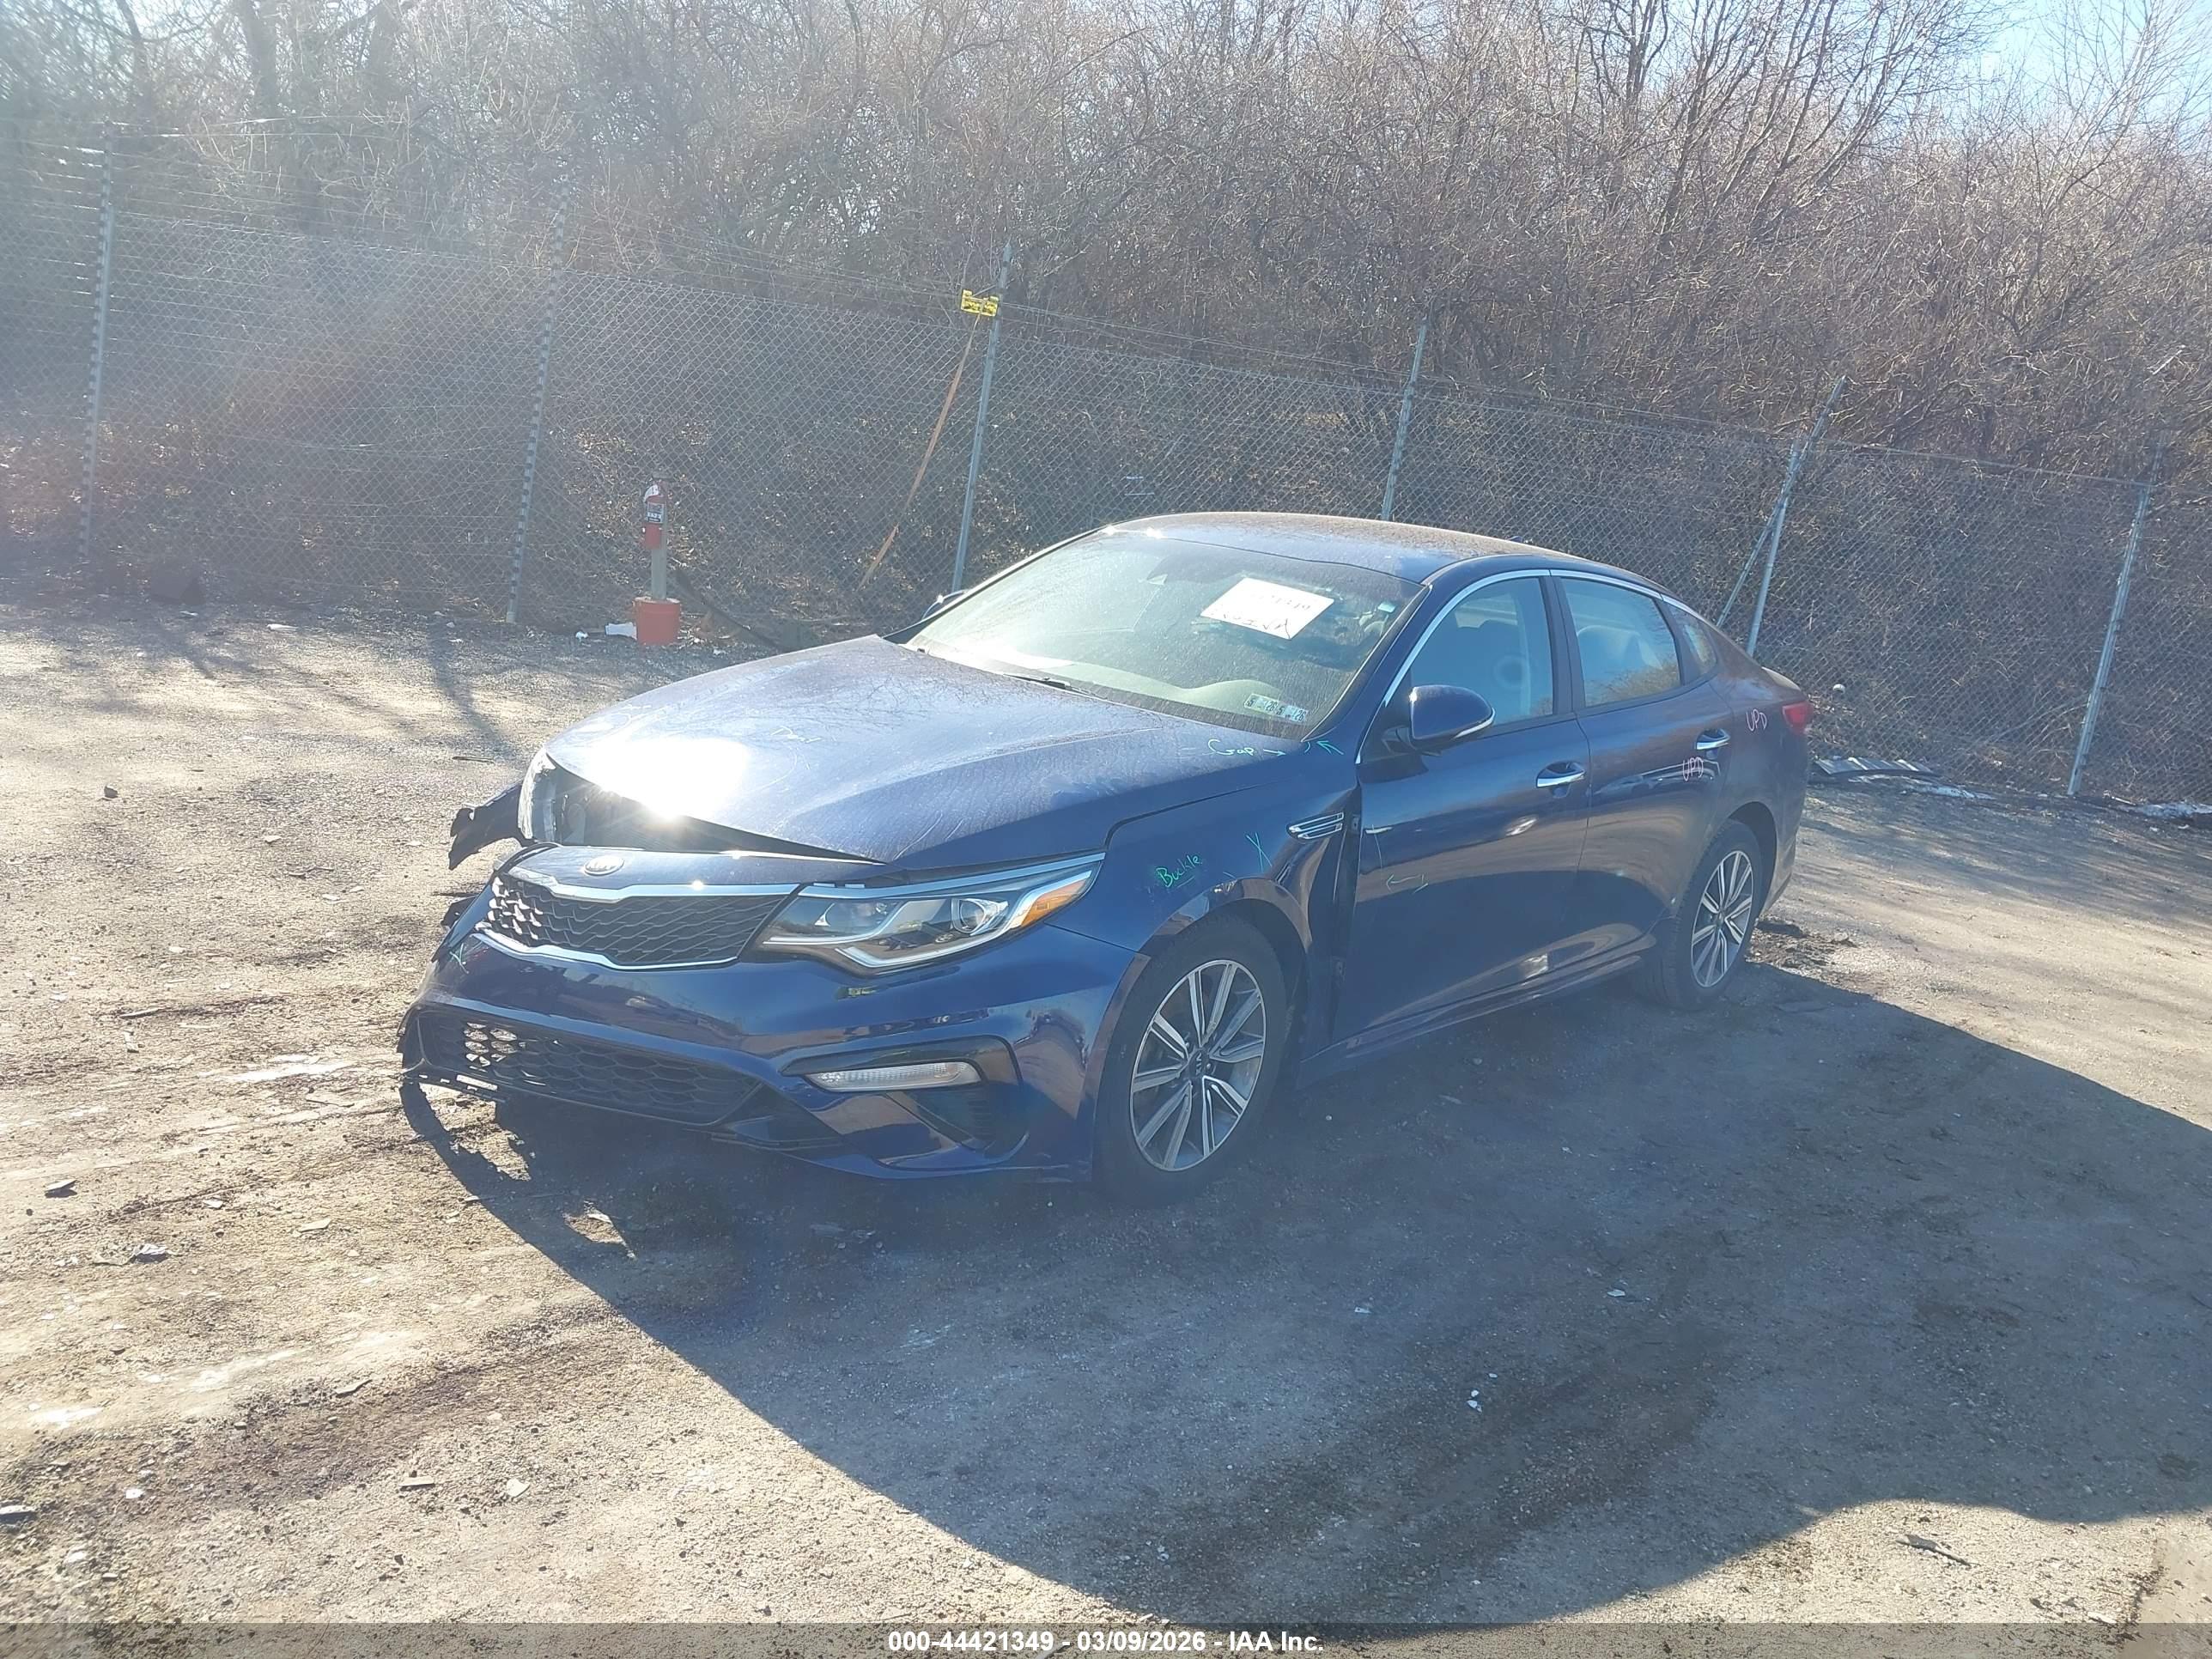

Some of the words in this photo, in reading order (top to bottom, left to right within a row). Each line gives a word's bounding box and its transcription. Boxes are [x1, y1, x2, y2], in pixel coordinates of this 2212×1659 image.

[1746, 708, 1767, 732] UPD
[1682, 757, 1705, 781] UPD
[1157, 854, 1200, 888] Buckle
